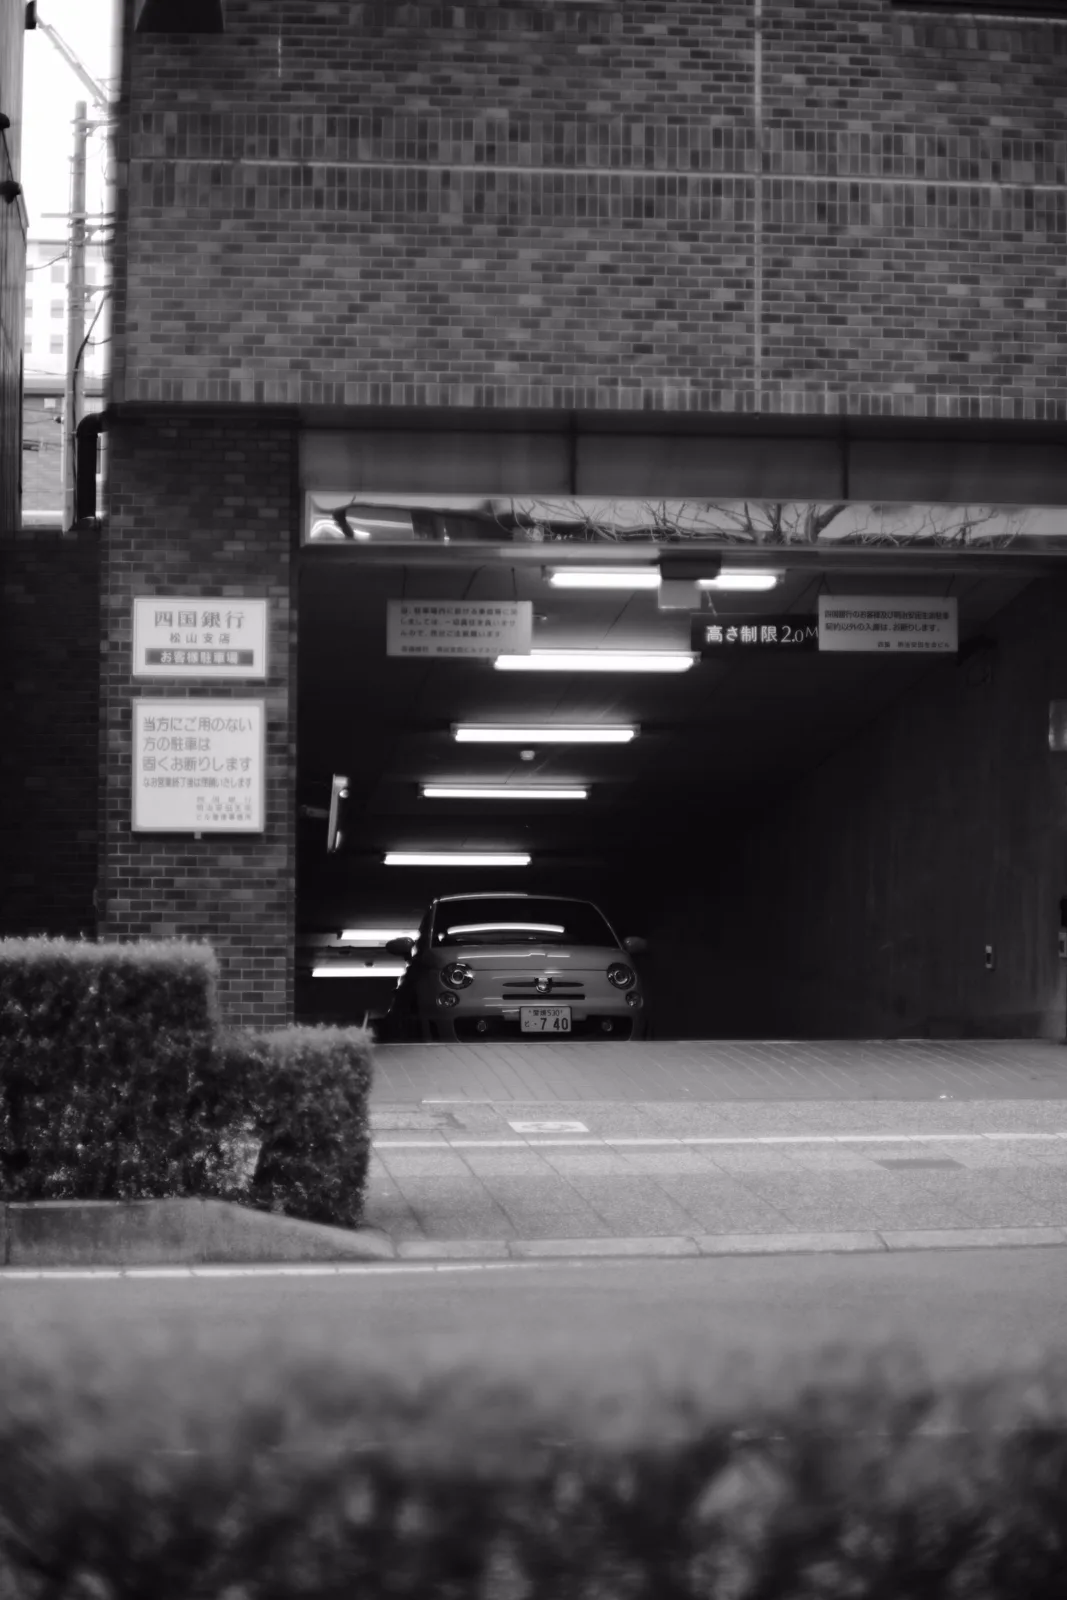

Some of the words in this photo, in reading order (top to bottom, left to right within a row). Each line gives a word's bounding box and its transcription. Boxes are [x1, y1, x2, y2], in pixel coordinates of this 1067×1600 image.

[154, 610, 245, 629] 四国銀行
[169, 633, 231, 645] 松山支店
[160, 651, 239, 665] お客様駐車場
[143, 716, 253, 733] 当方にご用のない
[143, 736, 211, 752] 方の駐車は
[142, 756, 252, 772] 固くお断りします
